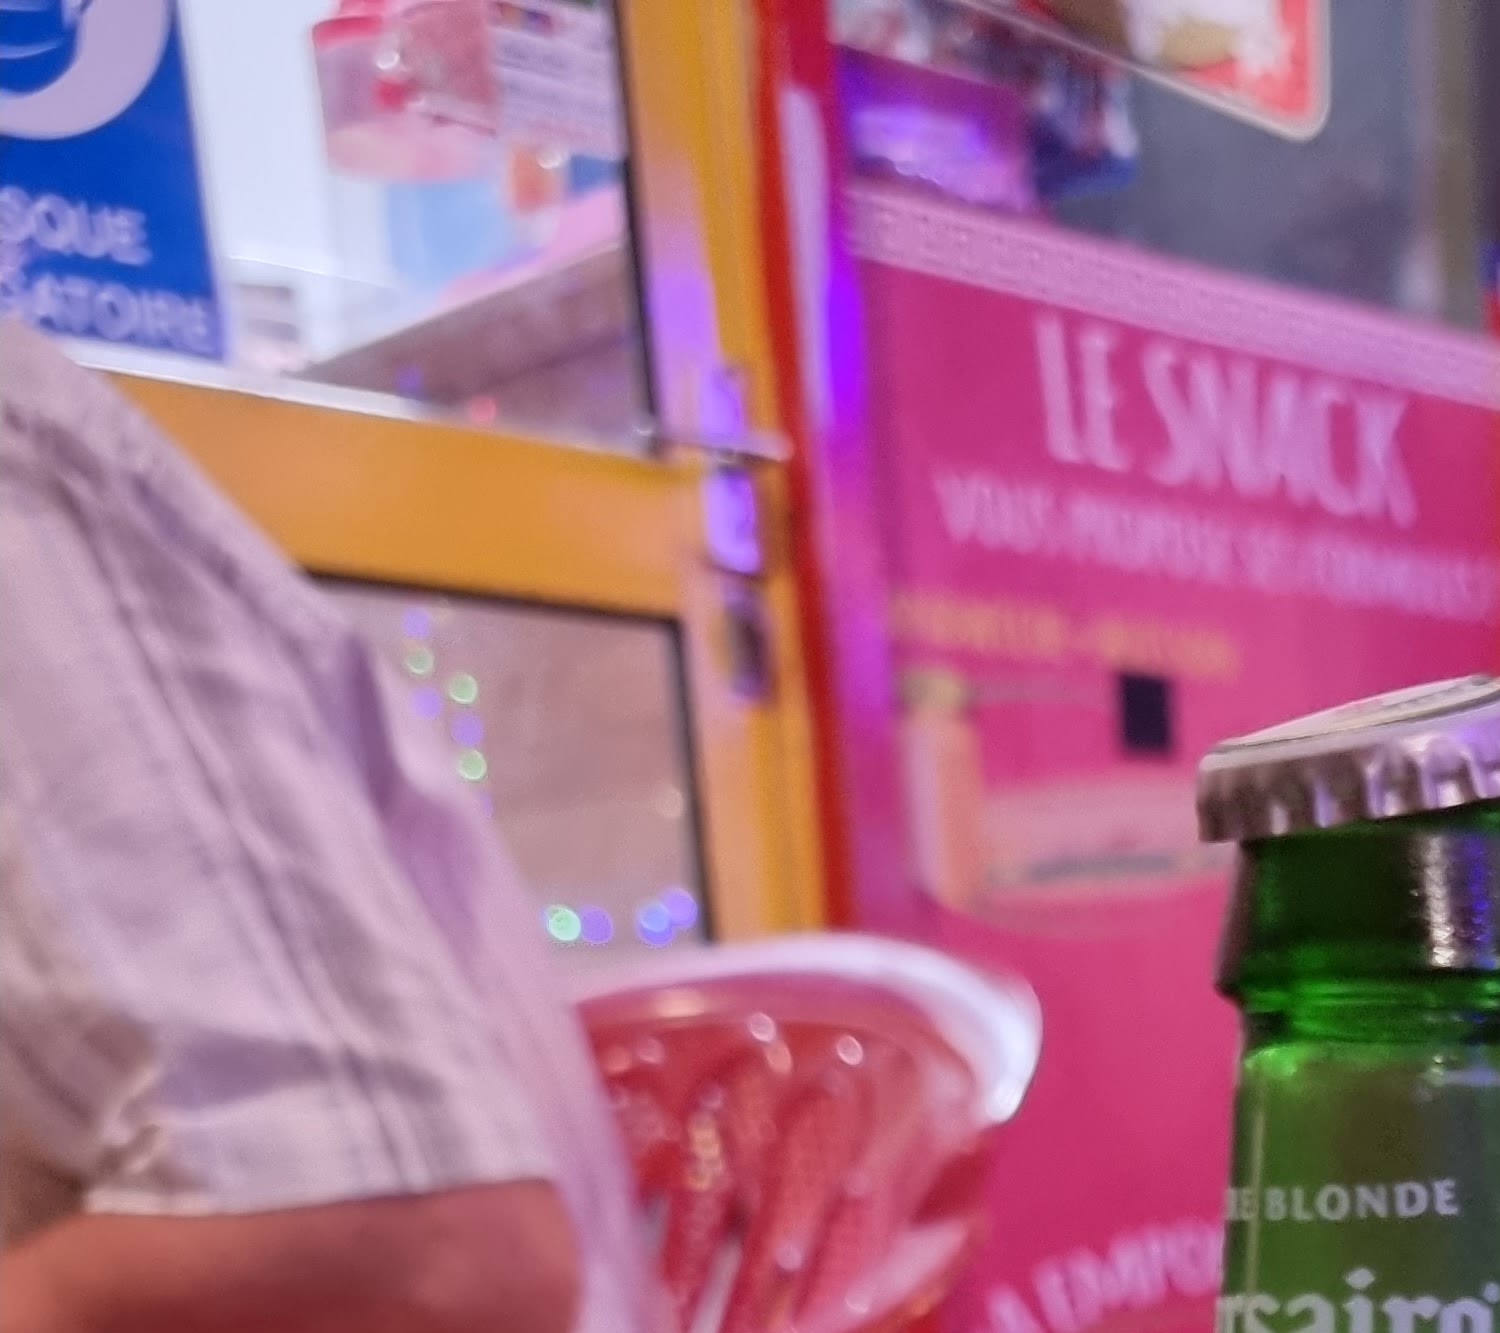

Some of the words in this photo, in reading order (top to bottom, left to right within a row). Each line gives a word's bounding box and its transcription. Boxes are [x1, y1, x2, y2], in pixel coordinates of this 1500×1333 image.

[1034, 312, 1132, 472] LE
[1142, 338, 1417, 528] SNACK
[1265, 1177, 1460, 1222] BLONDE
